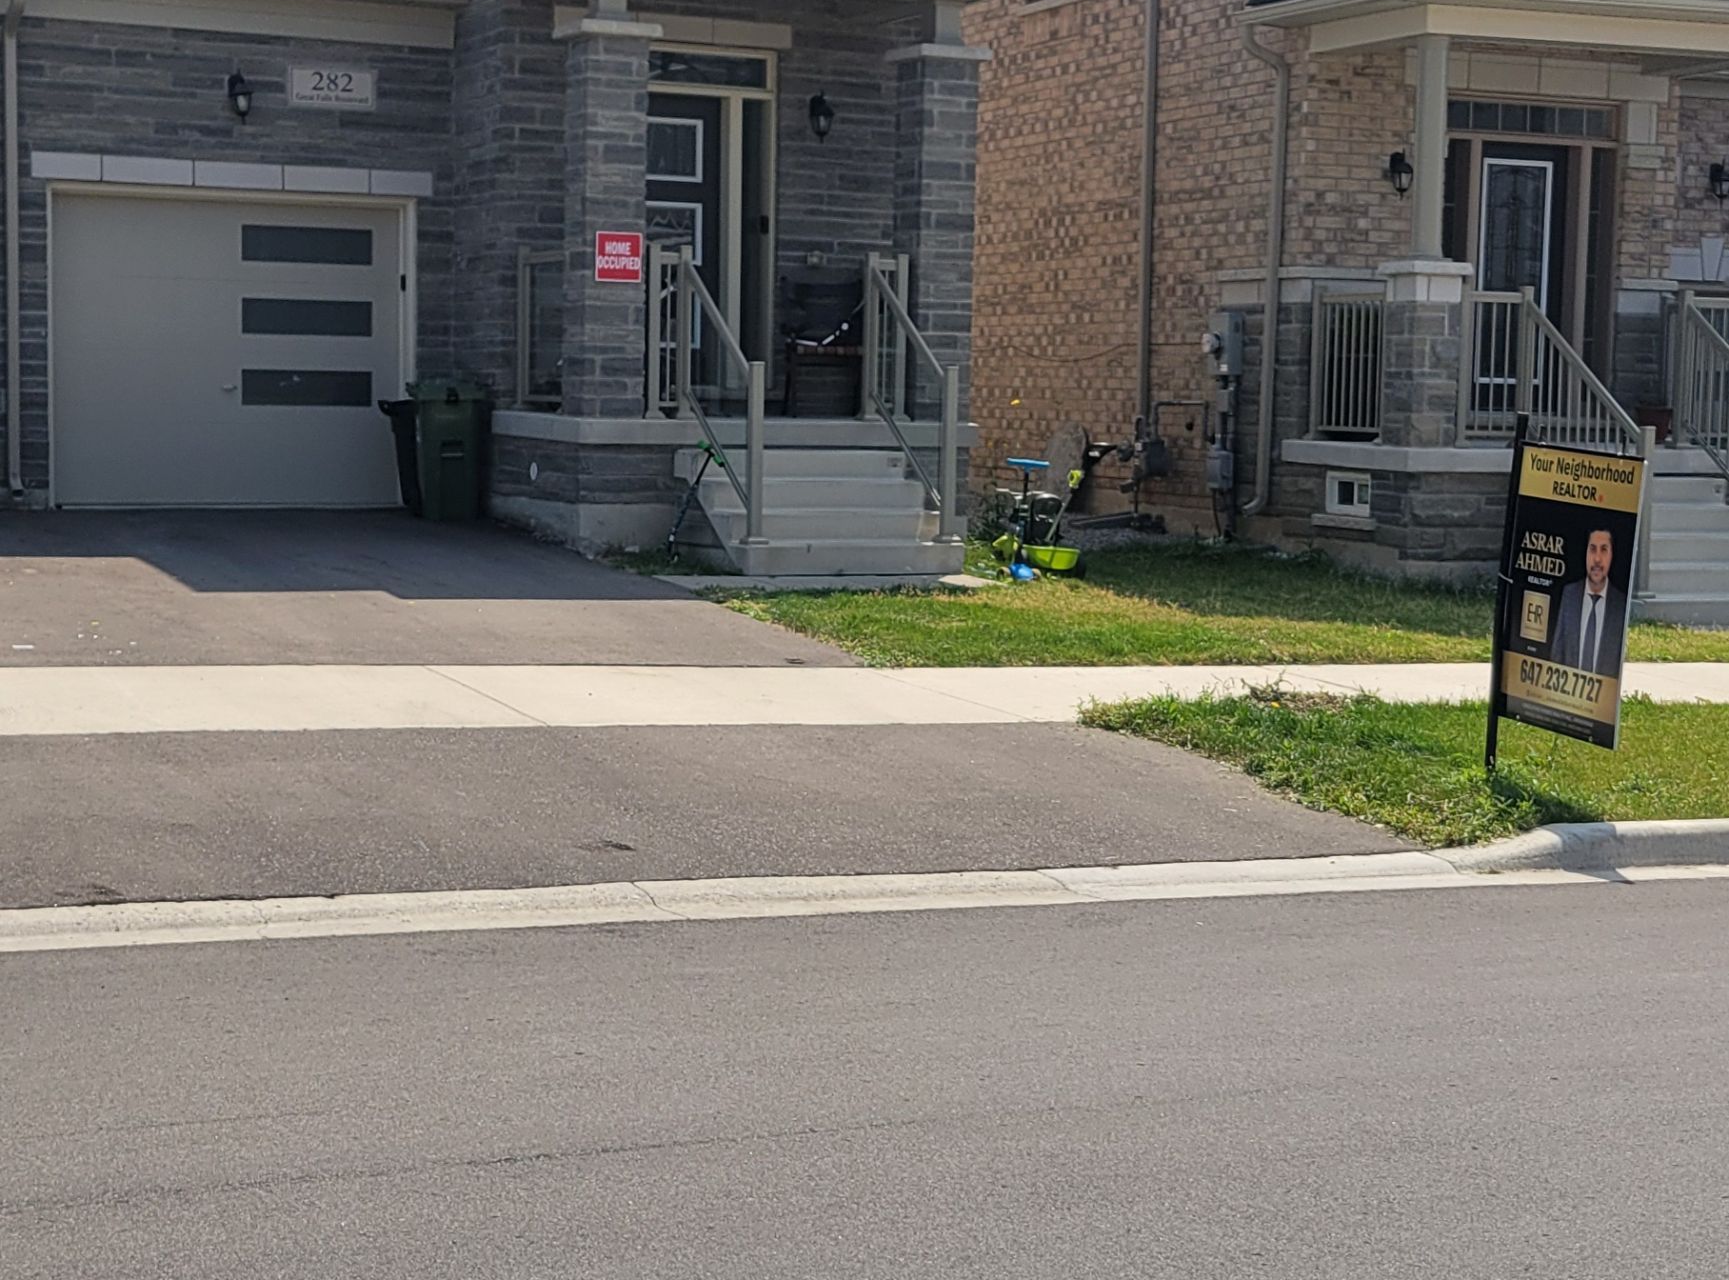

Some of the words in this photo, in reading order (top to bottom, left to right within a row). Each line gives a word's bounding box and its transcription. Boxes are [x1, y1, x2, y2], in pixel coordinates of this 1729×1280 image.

[312, 71, 354, 93] 282
[604, 241, 631, 255] HOME
[597, 255, 640, 270] OCCUPIED
[1530, 453, 1554, 473] Your
[1556, 457, 1635, 485] Neighborhood
[1521, 530, 1564, 555] ASRAR
[1515, 551, 1566, 577] AHMED
[1520, 658, 1603, 703] 647.232.7727
